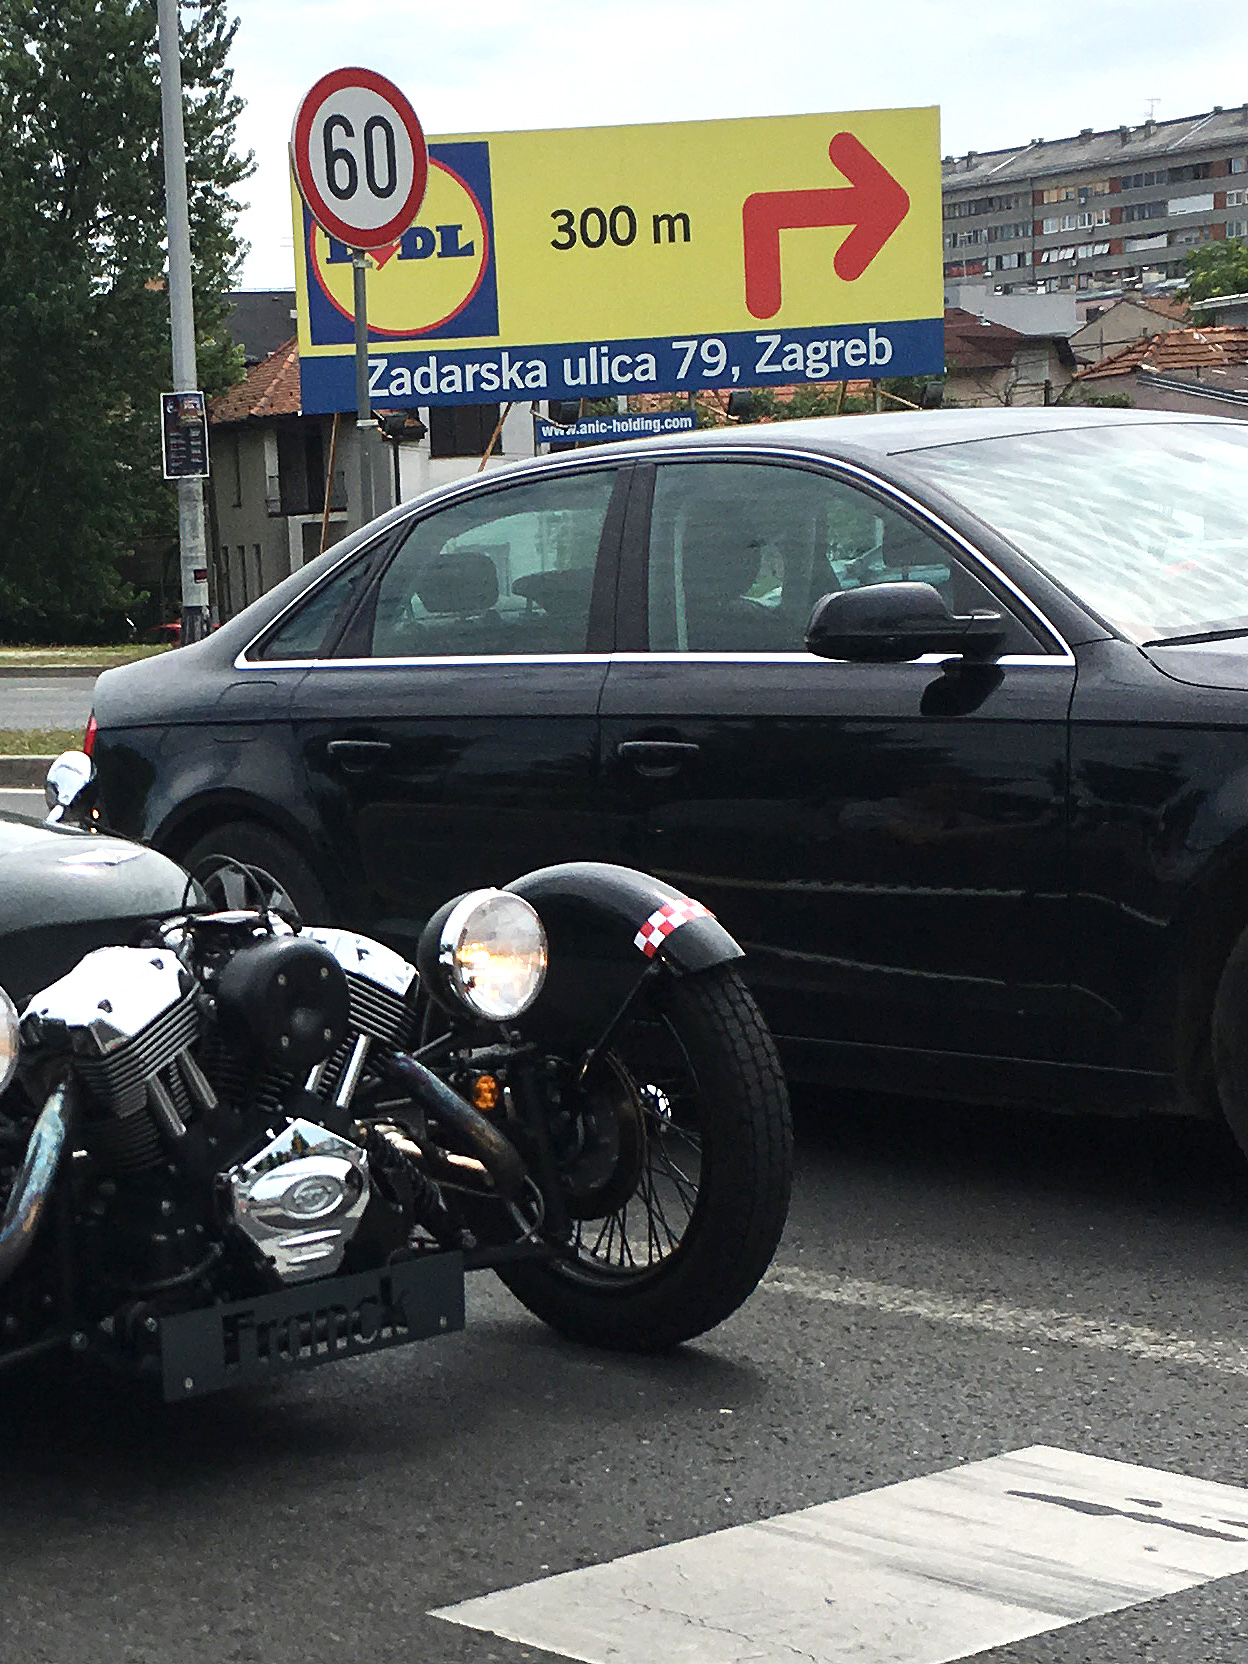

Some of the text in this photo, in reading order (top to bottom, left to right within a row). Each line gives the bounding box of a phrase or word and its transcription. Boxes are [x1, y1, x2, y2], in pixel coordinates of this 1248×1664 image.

[323, 114, 397, 200] 60
[550, 205, 691, 250] 300 m
[367, 328, 893, 398] Zadarska ulica 79, Zagreb
[220, 1278, 408, 1368] Franck
